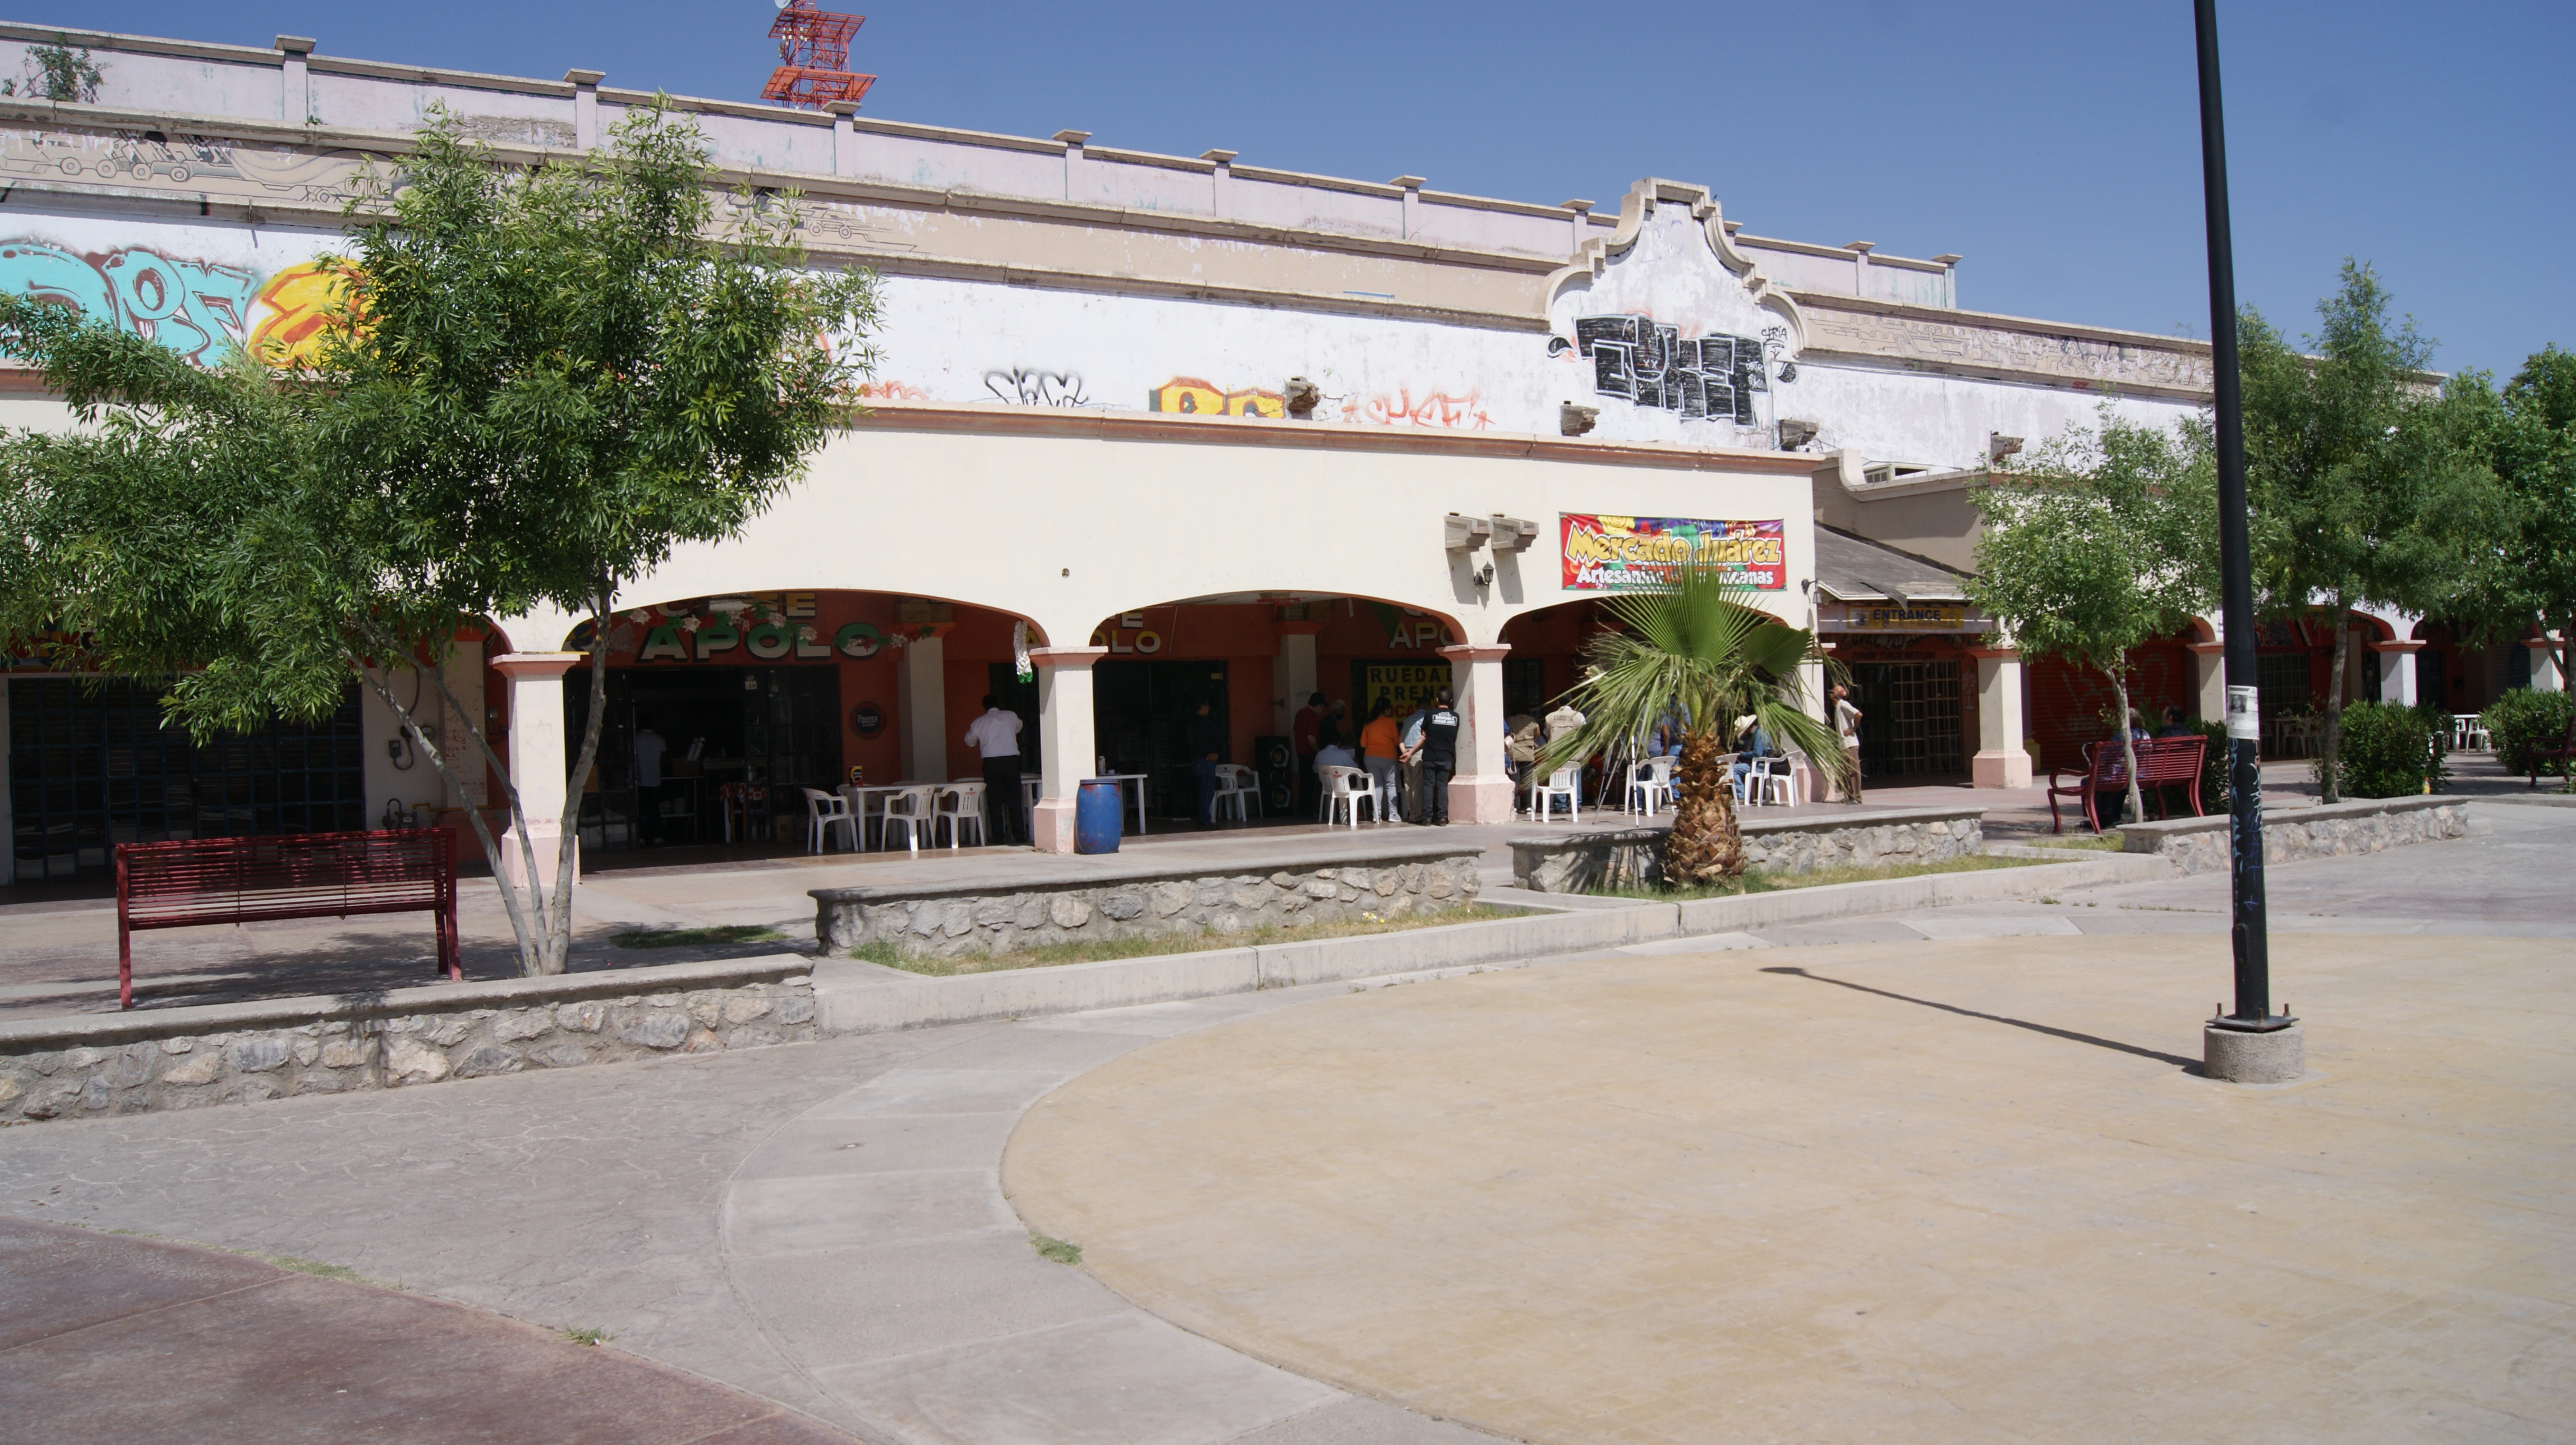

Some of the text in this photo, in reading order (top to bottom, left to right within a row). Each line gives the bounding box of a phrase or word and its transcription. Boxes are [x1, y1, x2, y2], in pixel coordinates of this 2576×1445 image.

[1566, 524, 1782, 564] Mercado Juárez
[1873, 609, 1941, 620] ENTRANCE
[636, 622, 882, 662] APOLO
[1370, 668, 1441, 683] RUEDA
